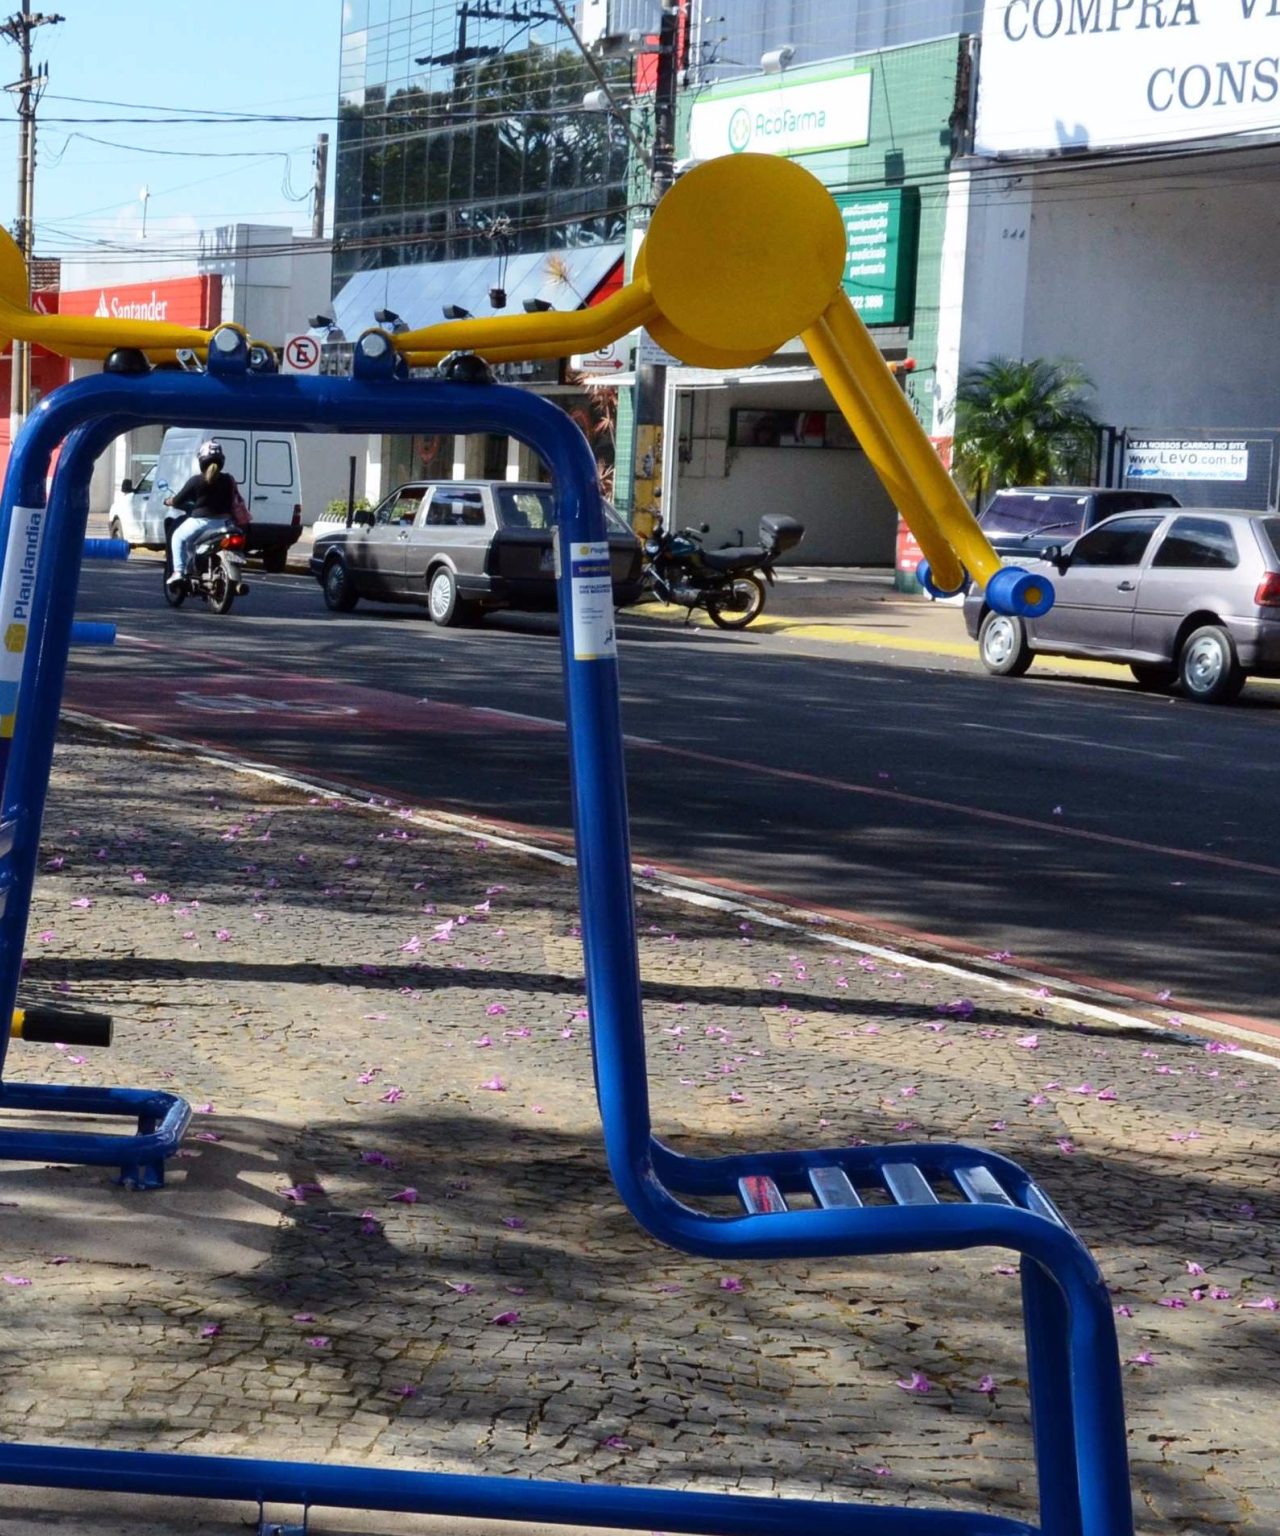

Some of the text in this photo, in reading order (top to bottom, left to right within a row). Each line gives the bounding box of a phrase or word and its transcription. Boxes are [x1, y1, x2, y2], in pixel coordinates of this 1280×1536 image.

[111, 290, 167, 320] Santander
[1181, 442, 1214, 450] CARROS
[1215, 442, 1227, 450] NO
